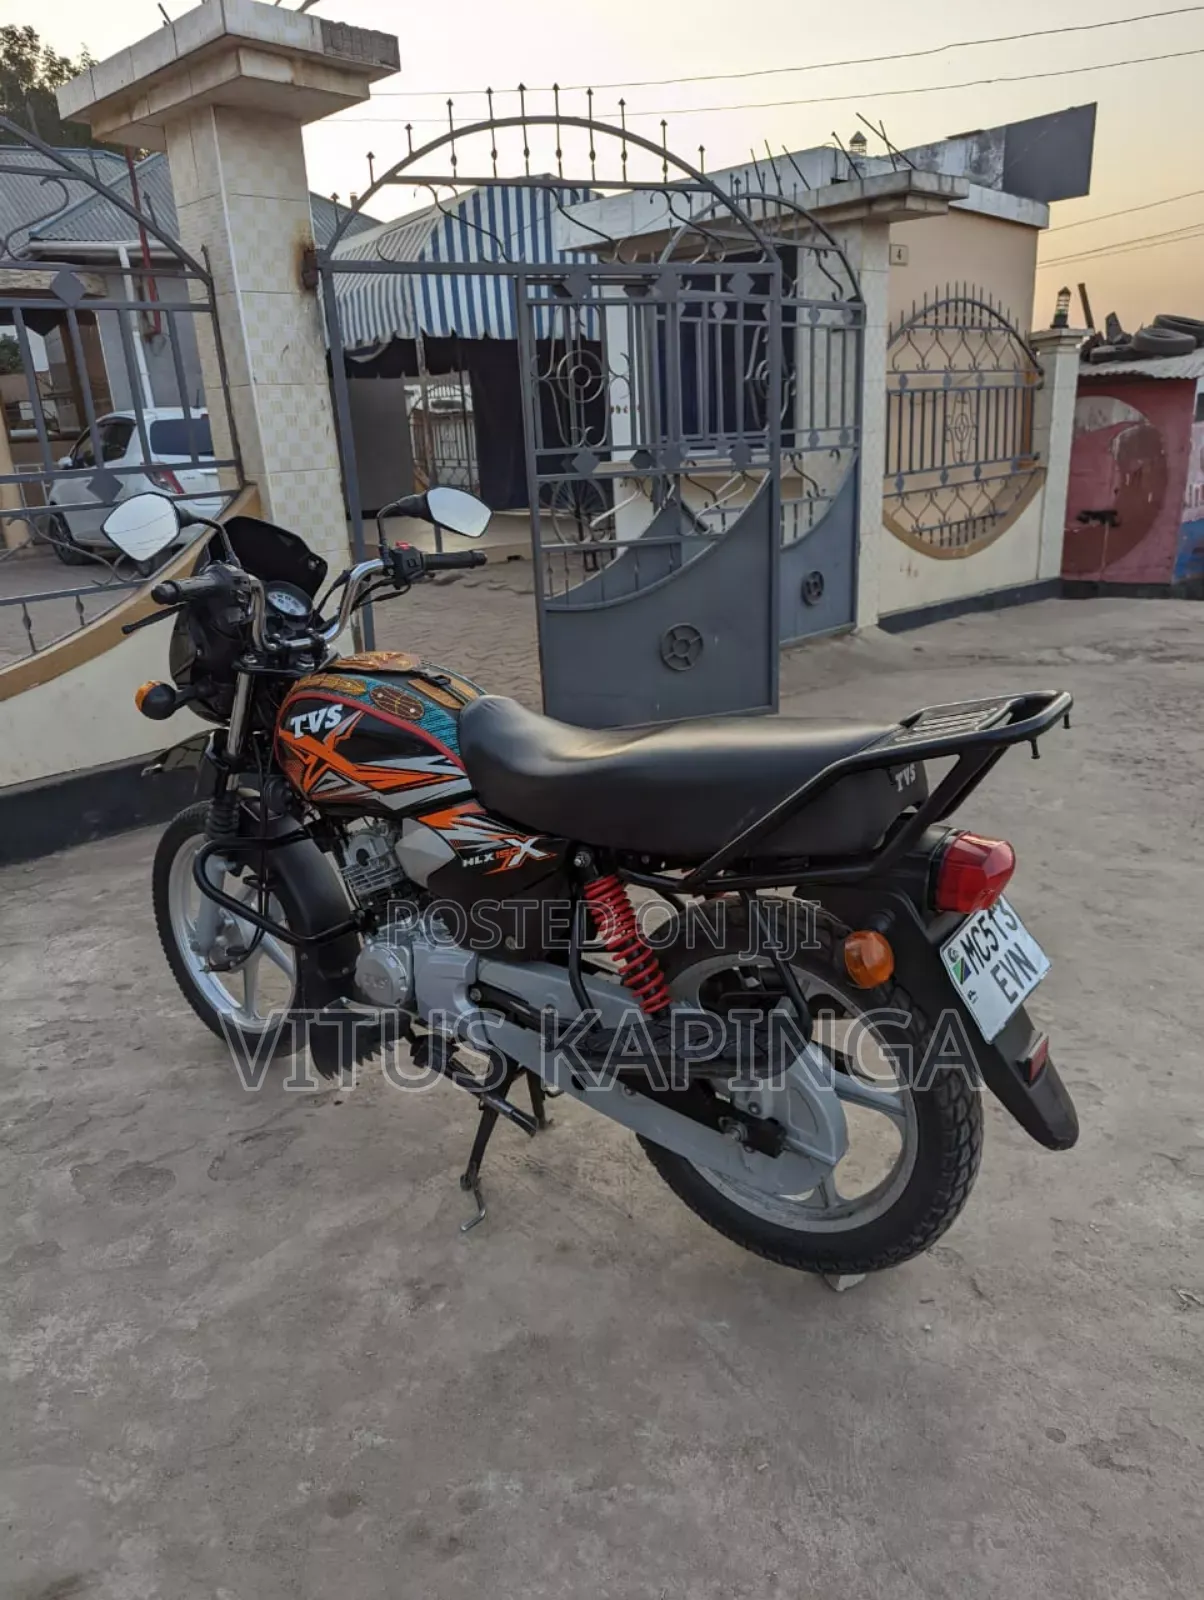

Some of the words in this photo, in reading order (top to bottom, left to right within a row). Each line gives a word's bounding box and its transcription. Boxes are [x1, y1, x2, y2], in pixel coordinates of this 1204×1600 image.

[289, 703, 344, 739] TVS
[894, 763, 916, 792] TVS
[989, 942, 1038, 1004] EVN
